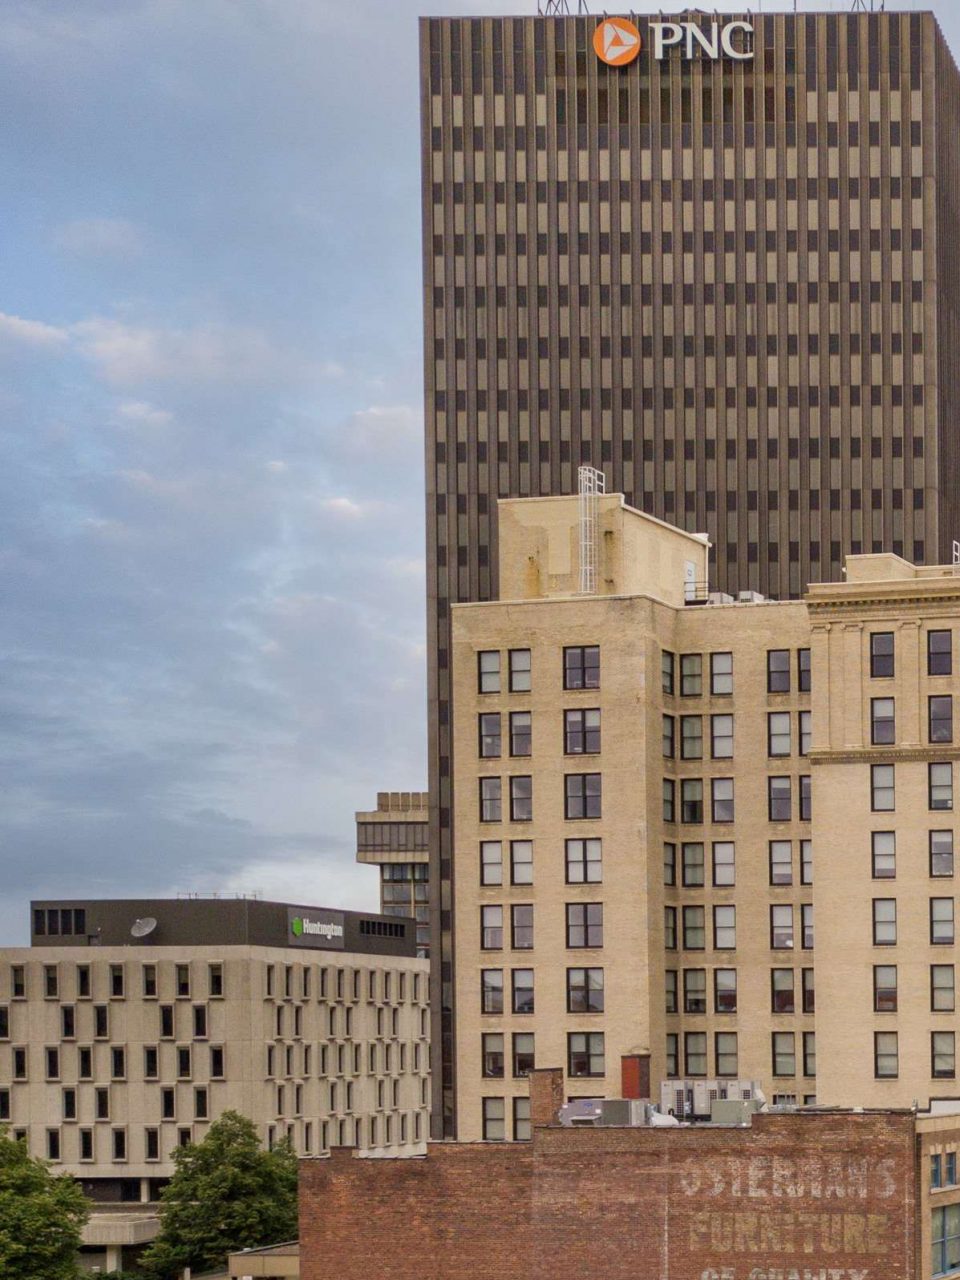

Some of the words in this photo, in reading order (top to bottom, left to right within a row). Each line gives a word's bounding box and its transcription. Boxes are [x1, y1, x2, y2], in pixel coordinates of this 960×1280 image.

[648, 21, 754, 59] PNC
[303, 918, 343, 940] Huntington
[688, 1212, 889, 1253] FURNITURE
